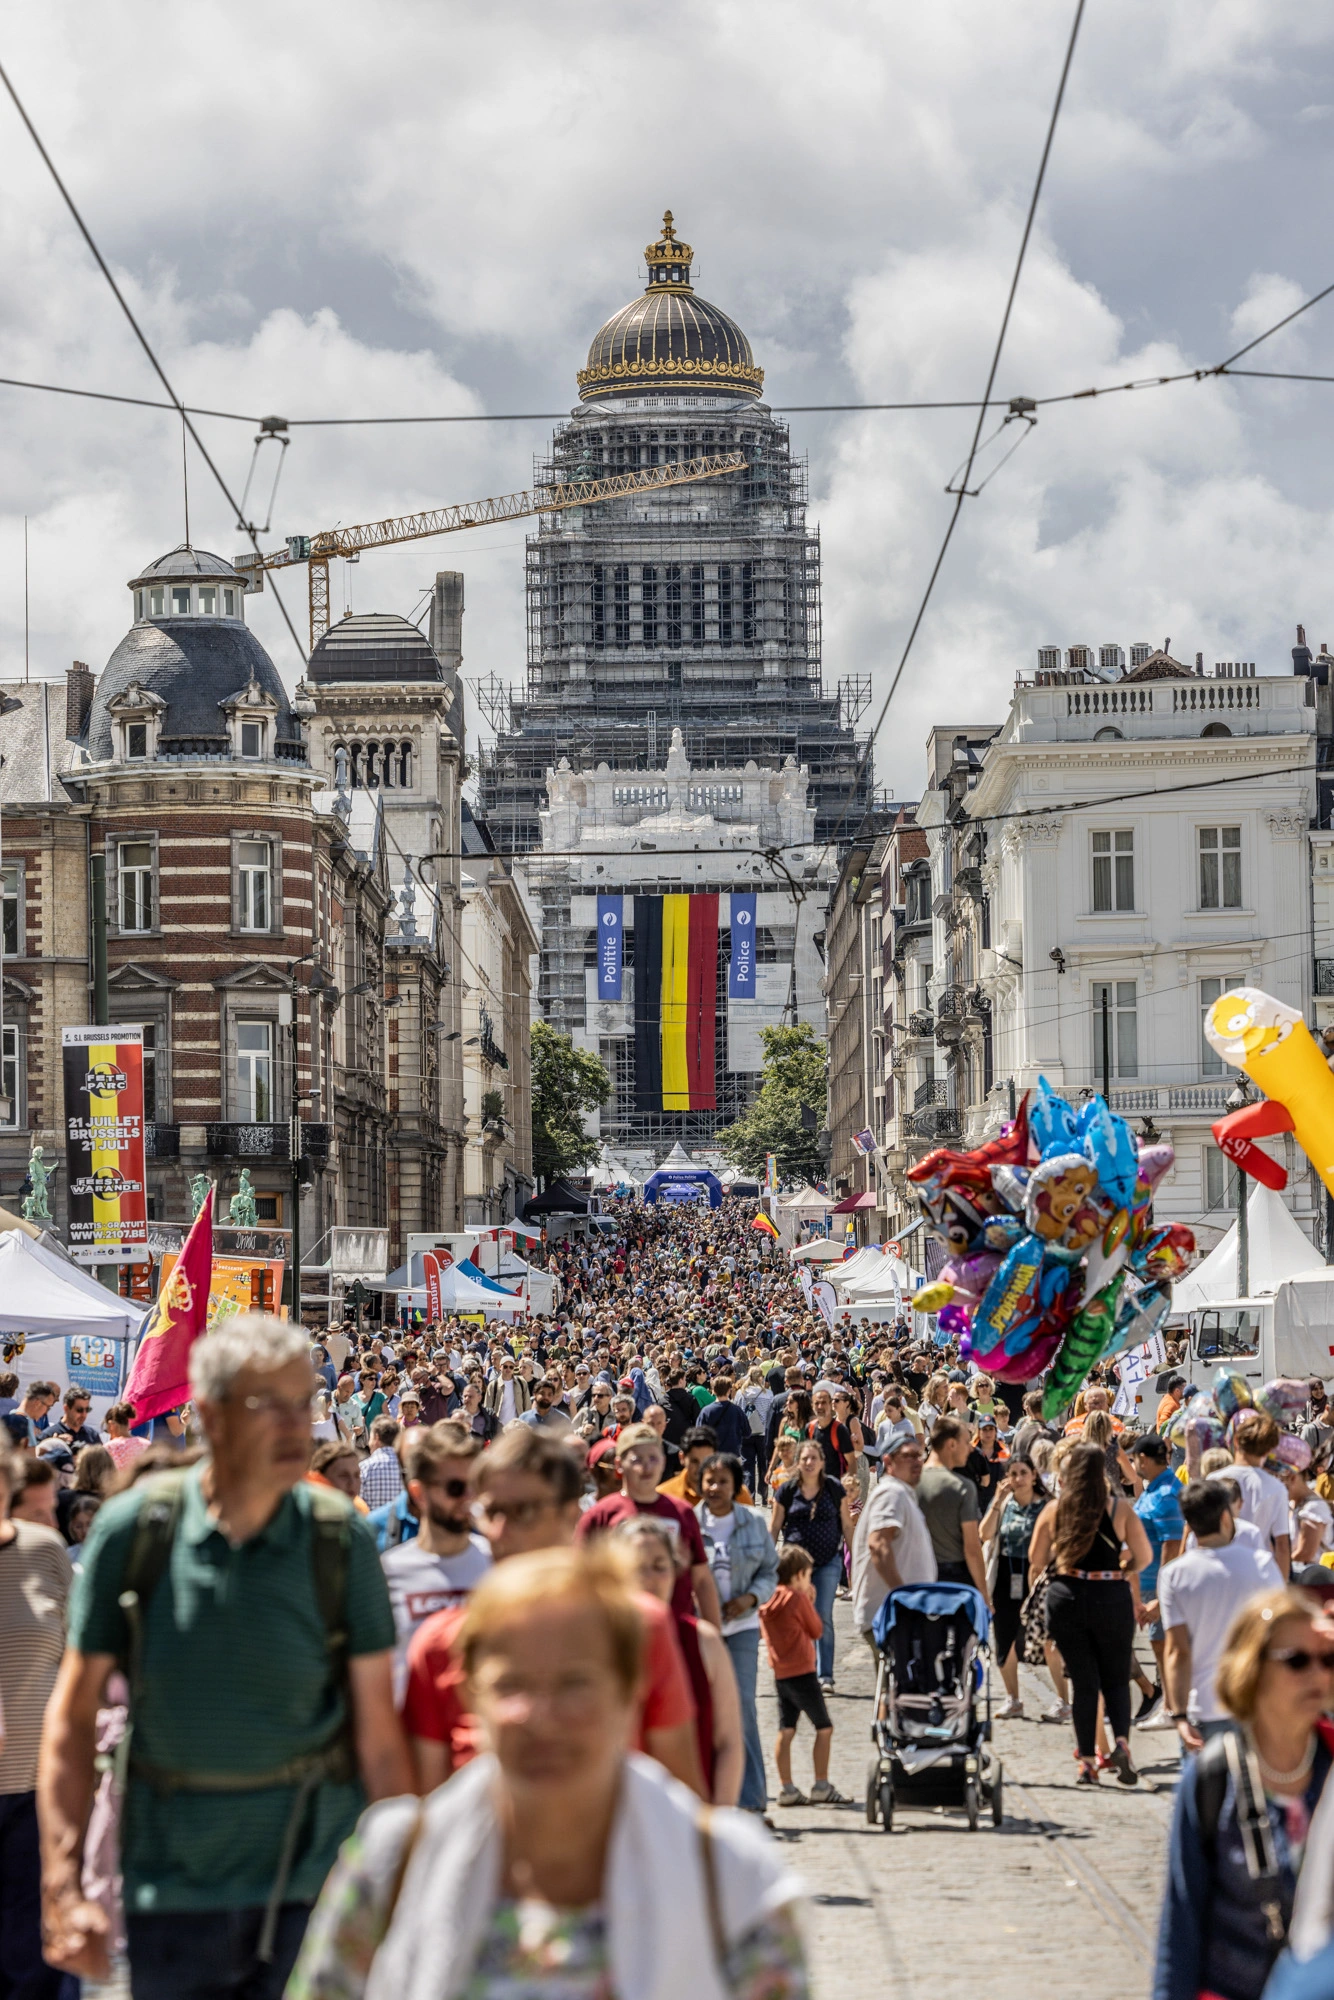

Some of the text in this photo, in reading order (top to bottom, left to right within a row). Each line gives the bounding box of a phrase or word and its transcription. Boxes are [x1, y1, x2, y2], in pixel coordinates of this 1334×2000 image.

[604, 937, 616, 983] Politie
[737, 941, 749, 982] Police
[84, 1033, 110, 1041] BRUSSELS
[111, 1032, 141, 1041] PROMOTION
[87, 1082, 126, 1090] PARC
[68, 1116, 140, 1128] 21 JUILLET
[70, 1128, 140, 1140] BRUSSELS
[82, 1139, 129, 1151] 21 JULI
[72, 1183, 140, 1193] WARANDE
[78, 1178, 121, 1187] FEEST
[70, 1222, 102, 1230] GRATIS
[107, 1220, 145, 1229] GRATUIT
[70, 1230, 146, 1240] WWW.2107.BE
[990, 1264, 1037, 1335] SPIDER-MAN
[80, 1336, 105, 1354] 19
